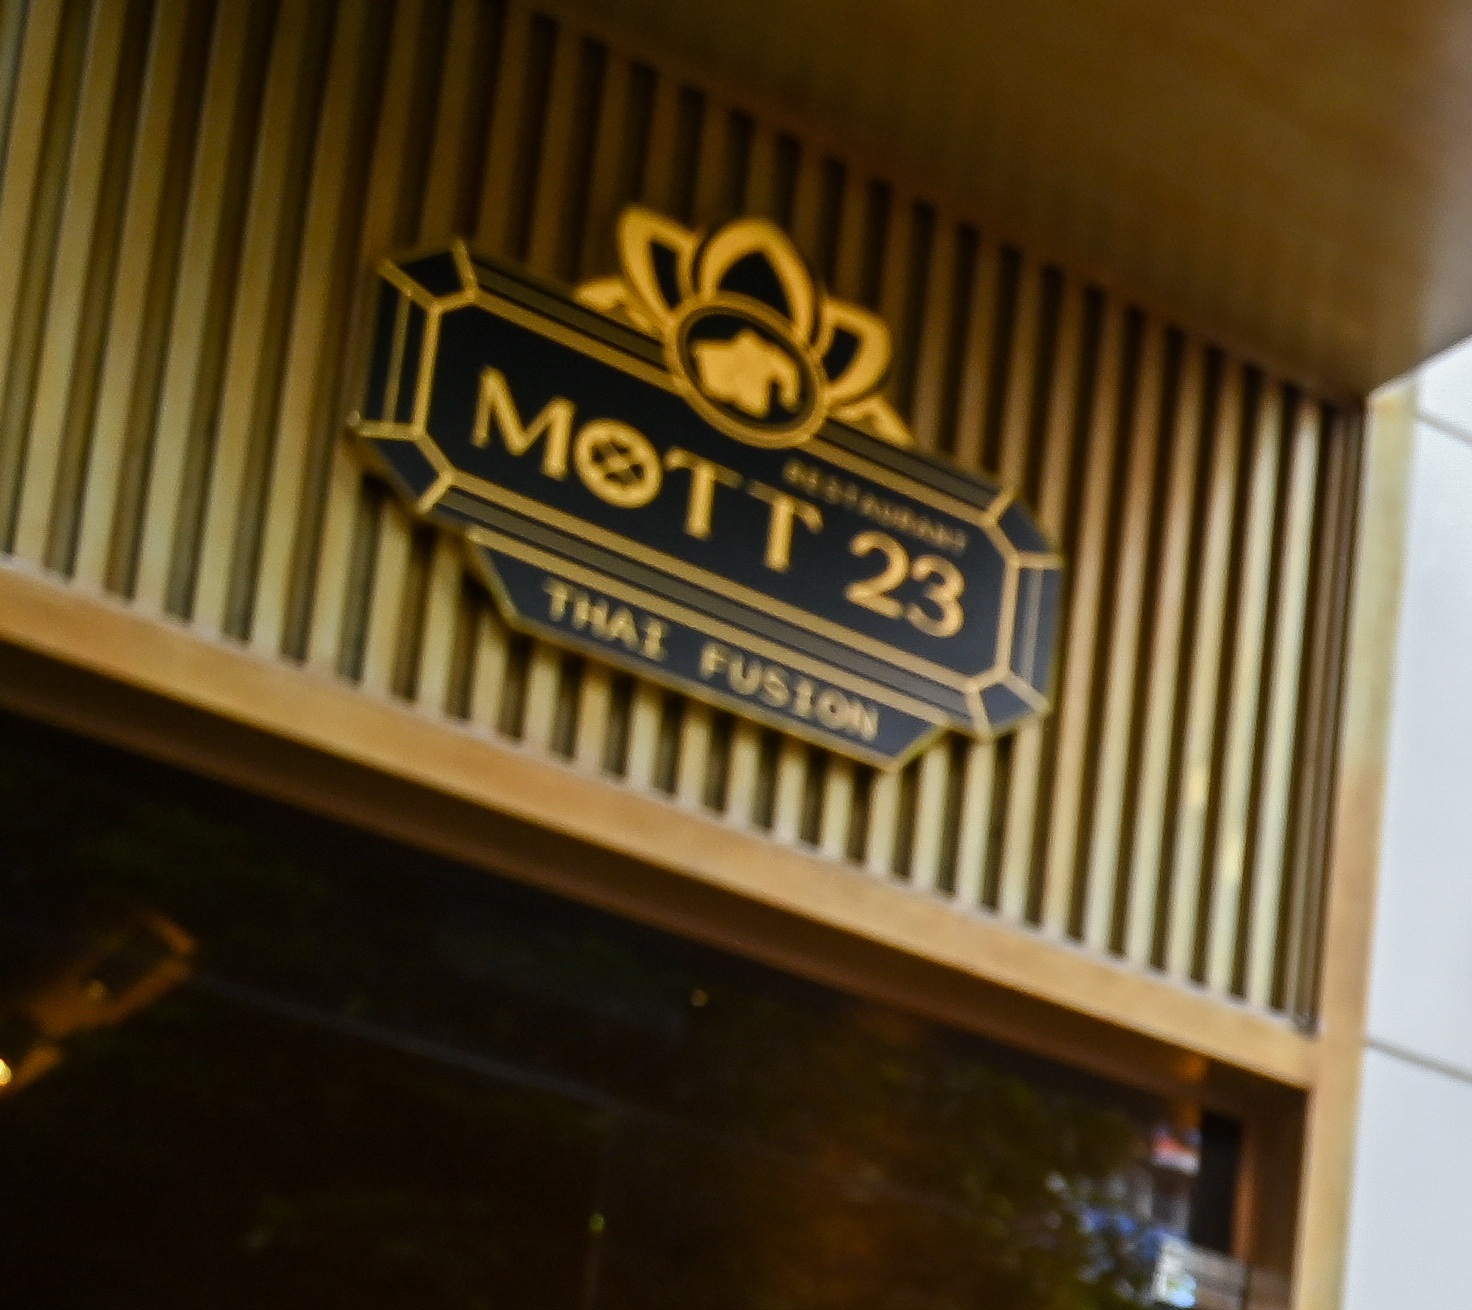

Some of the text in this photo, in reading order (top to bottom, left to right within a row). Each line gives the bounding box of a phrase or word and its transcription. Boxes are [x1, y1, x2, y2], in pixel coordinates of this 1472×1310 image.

[846, 530, 966, 640] 23
[542, 580, 879, 743] THAI FUSION
